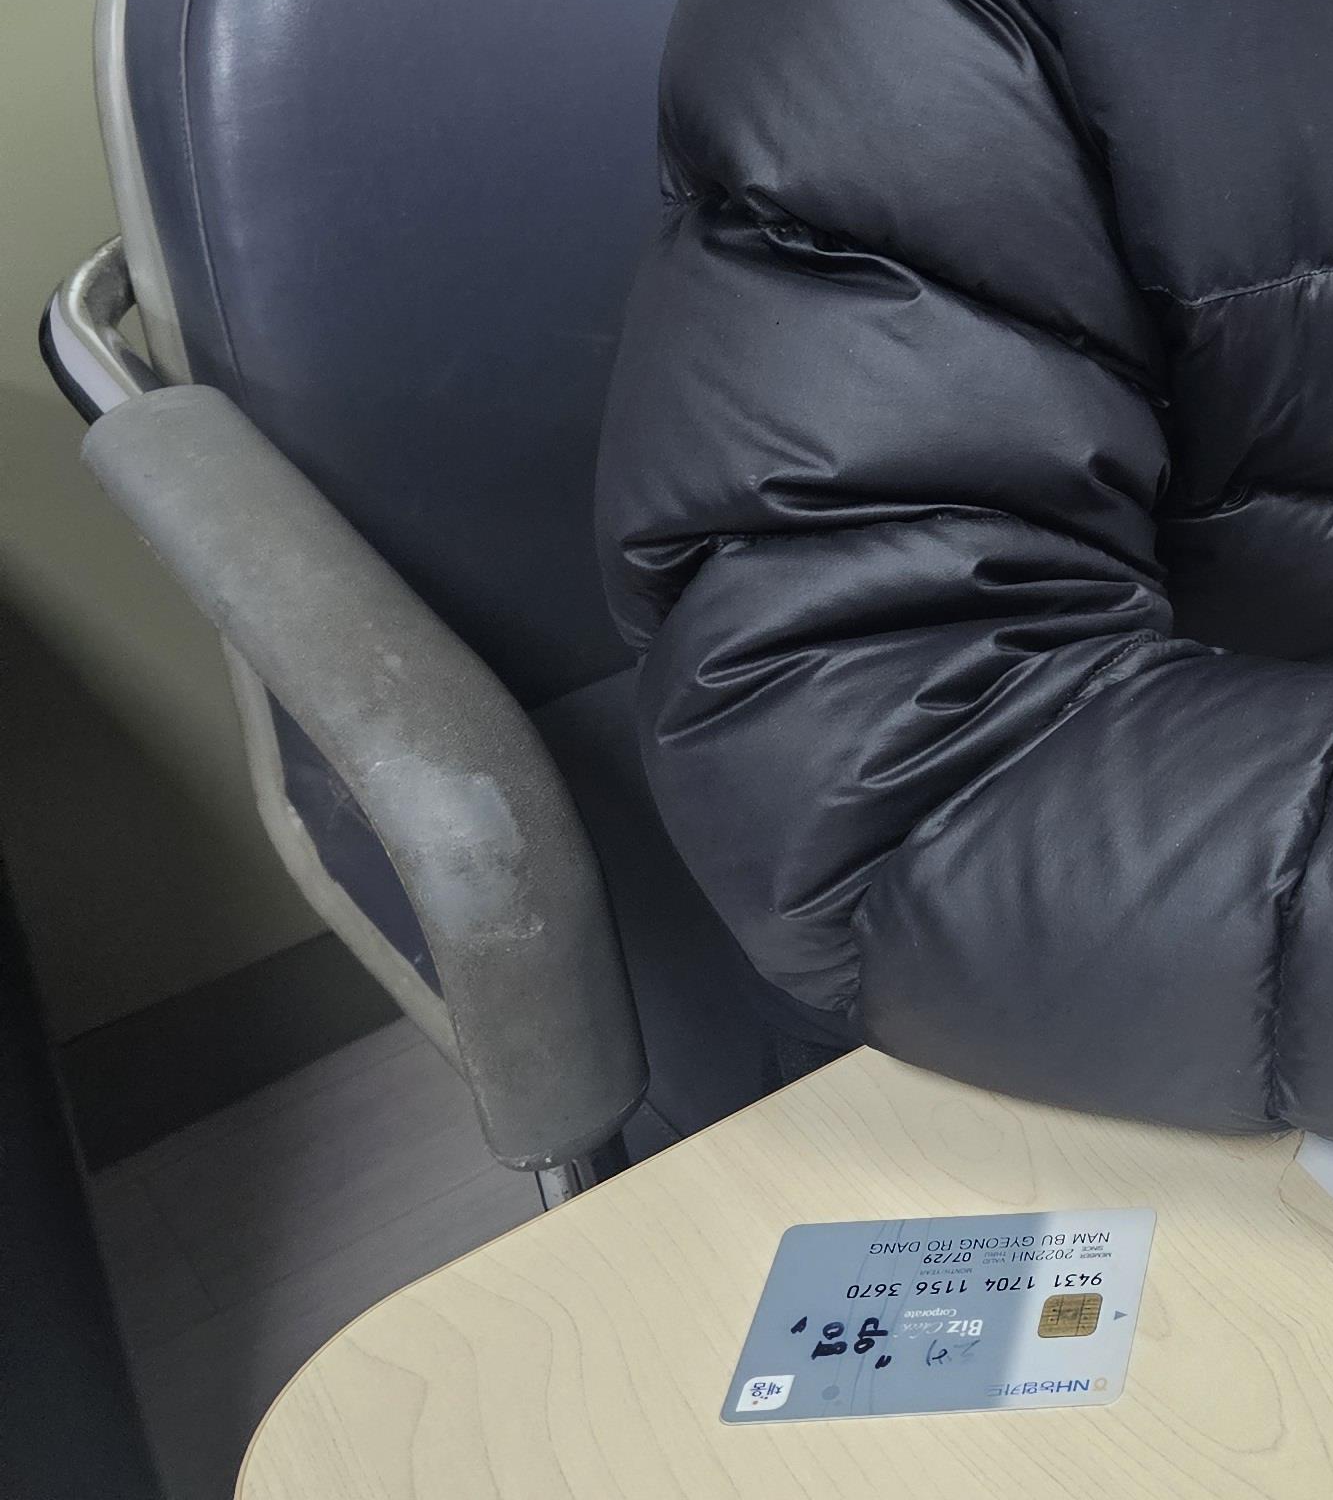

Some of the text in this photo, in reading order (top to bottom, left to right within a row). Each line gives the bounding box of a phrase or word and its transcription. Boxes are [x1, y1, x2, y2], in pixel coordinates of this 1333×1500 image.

[869, 1232, 1111, 1255] NAM BU GYEONG RO DANG
[923, 1251, 971, 1265] 07/29
[1012, 1249, 1073, 1263] 2022NH
[846, 1272, 1103, 1299] 9431 1704 1156 3670
[903, 1308, 957, 1319] Corporate
[947, 1318, 982, 1336] Biz
[986, 1378, 1090, 1397] NH농협카드
